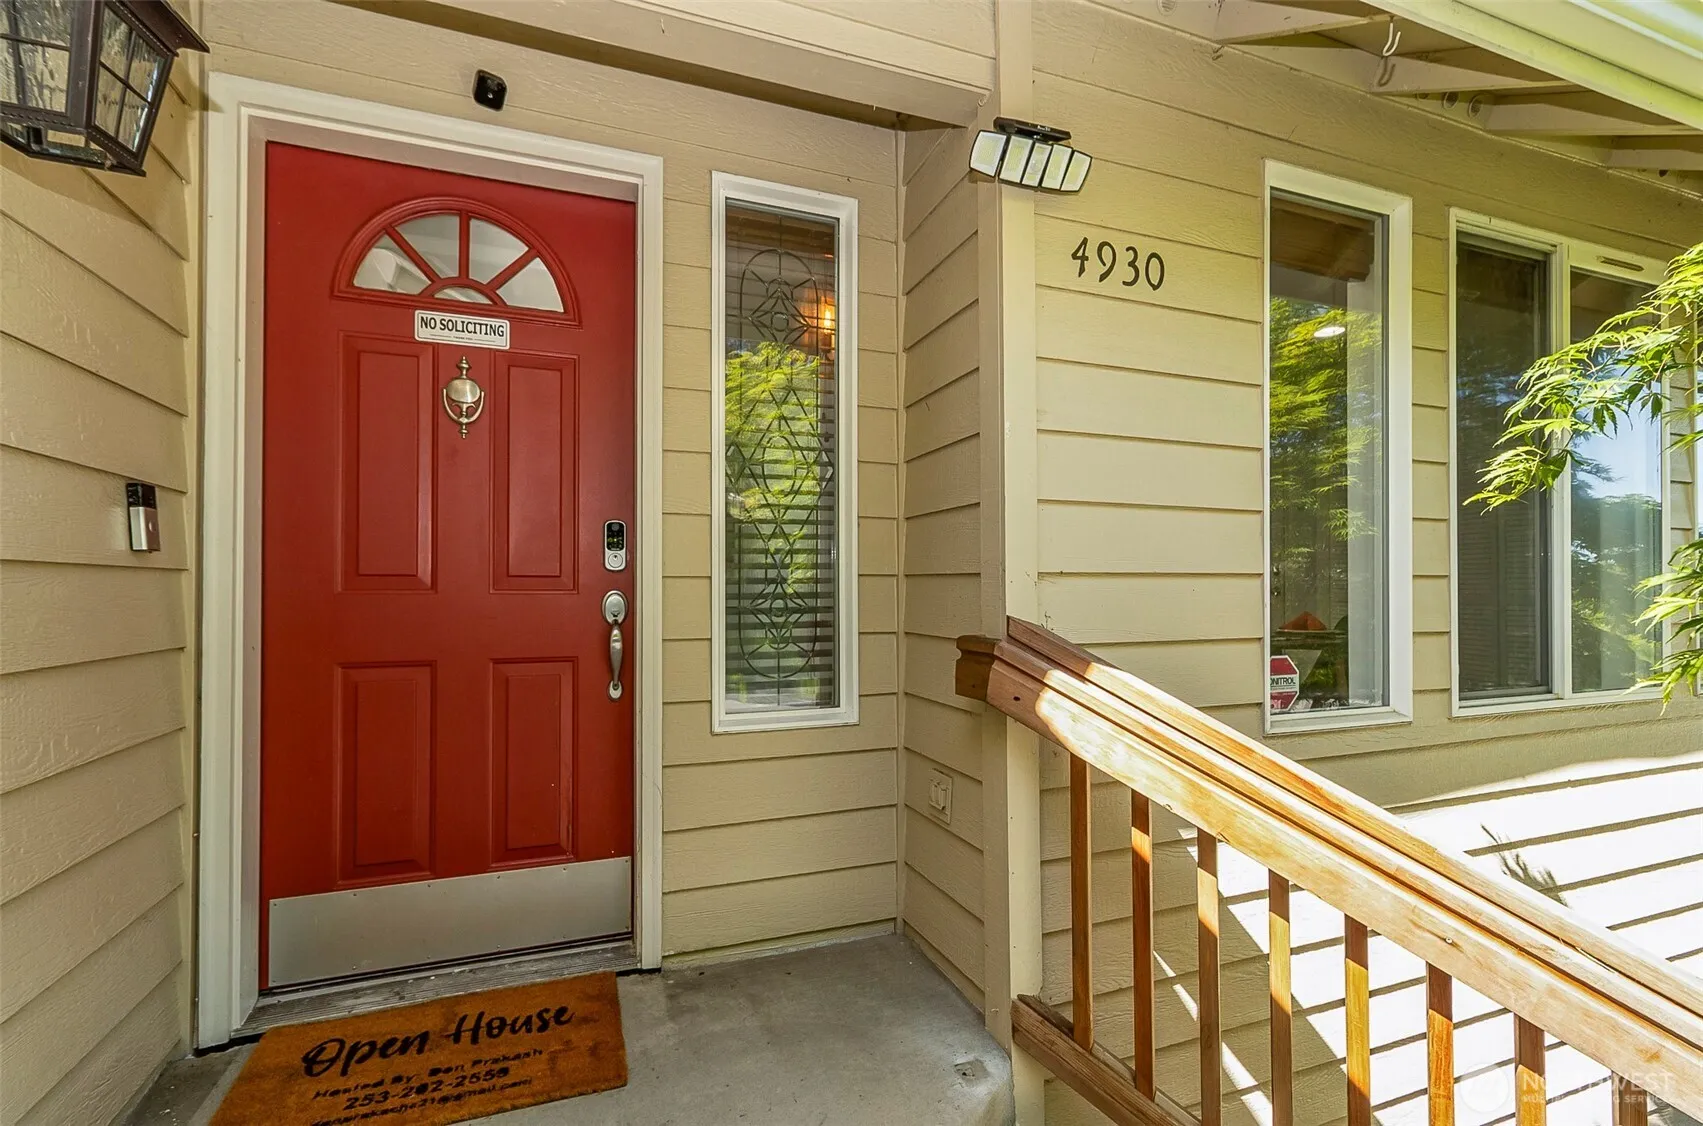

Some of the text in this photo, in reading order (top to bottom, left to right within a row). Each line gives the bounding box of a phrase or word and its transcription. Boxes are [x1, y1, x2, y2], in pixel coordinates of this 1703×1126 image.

[1071, 237, 1165, 291] 4930
[420, 316, 504, 337] NO SOLICITING
[301, 1006, 575, 1078] Open House
